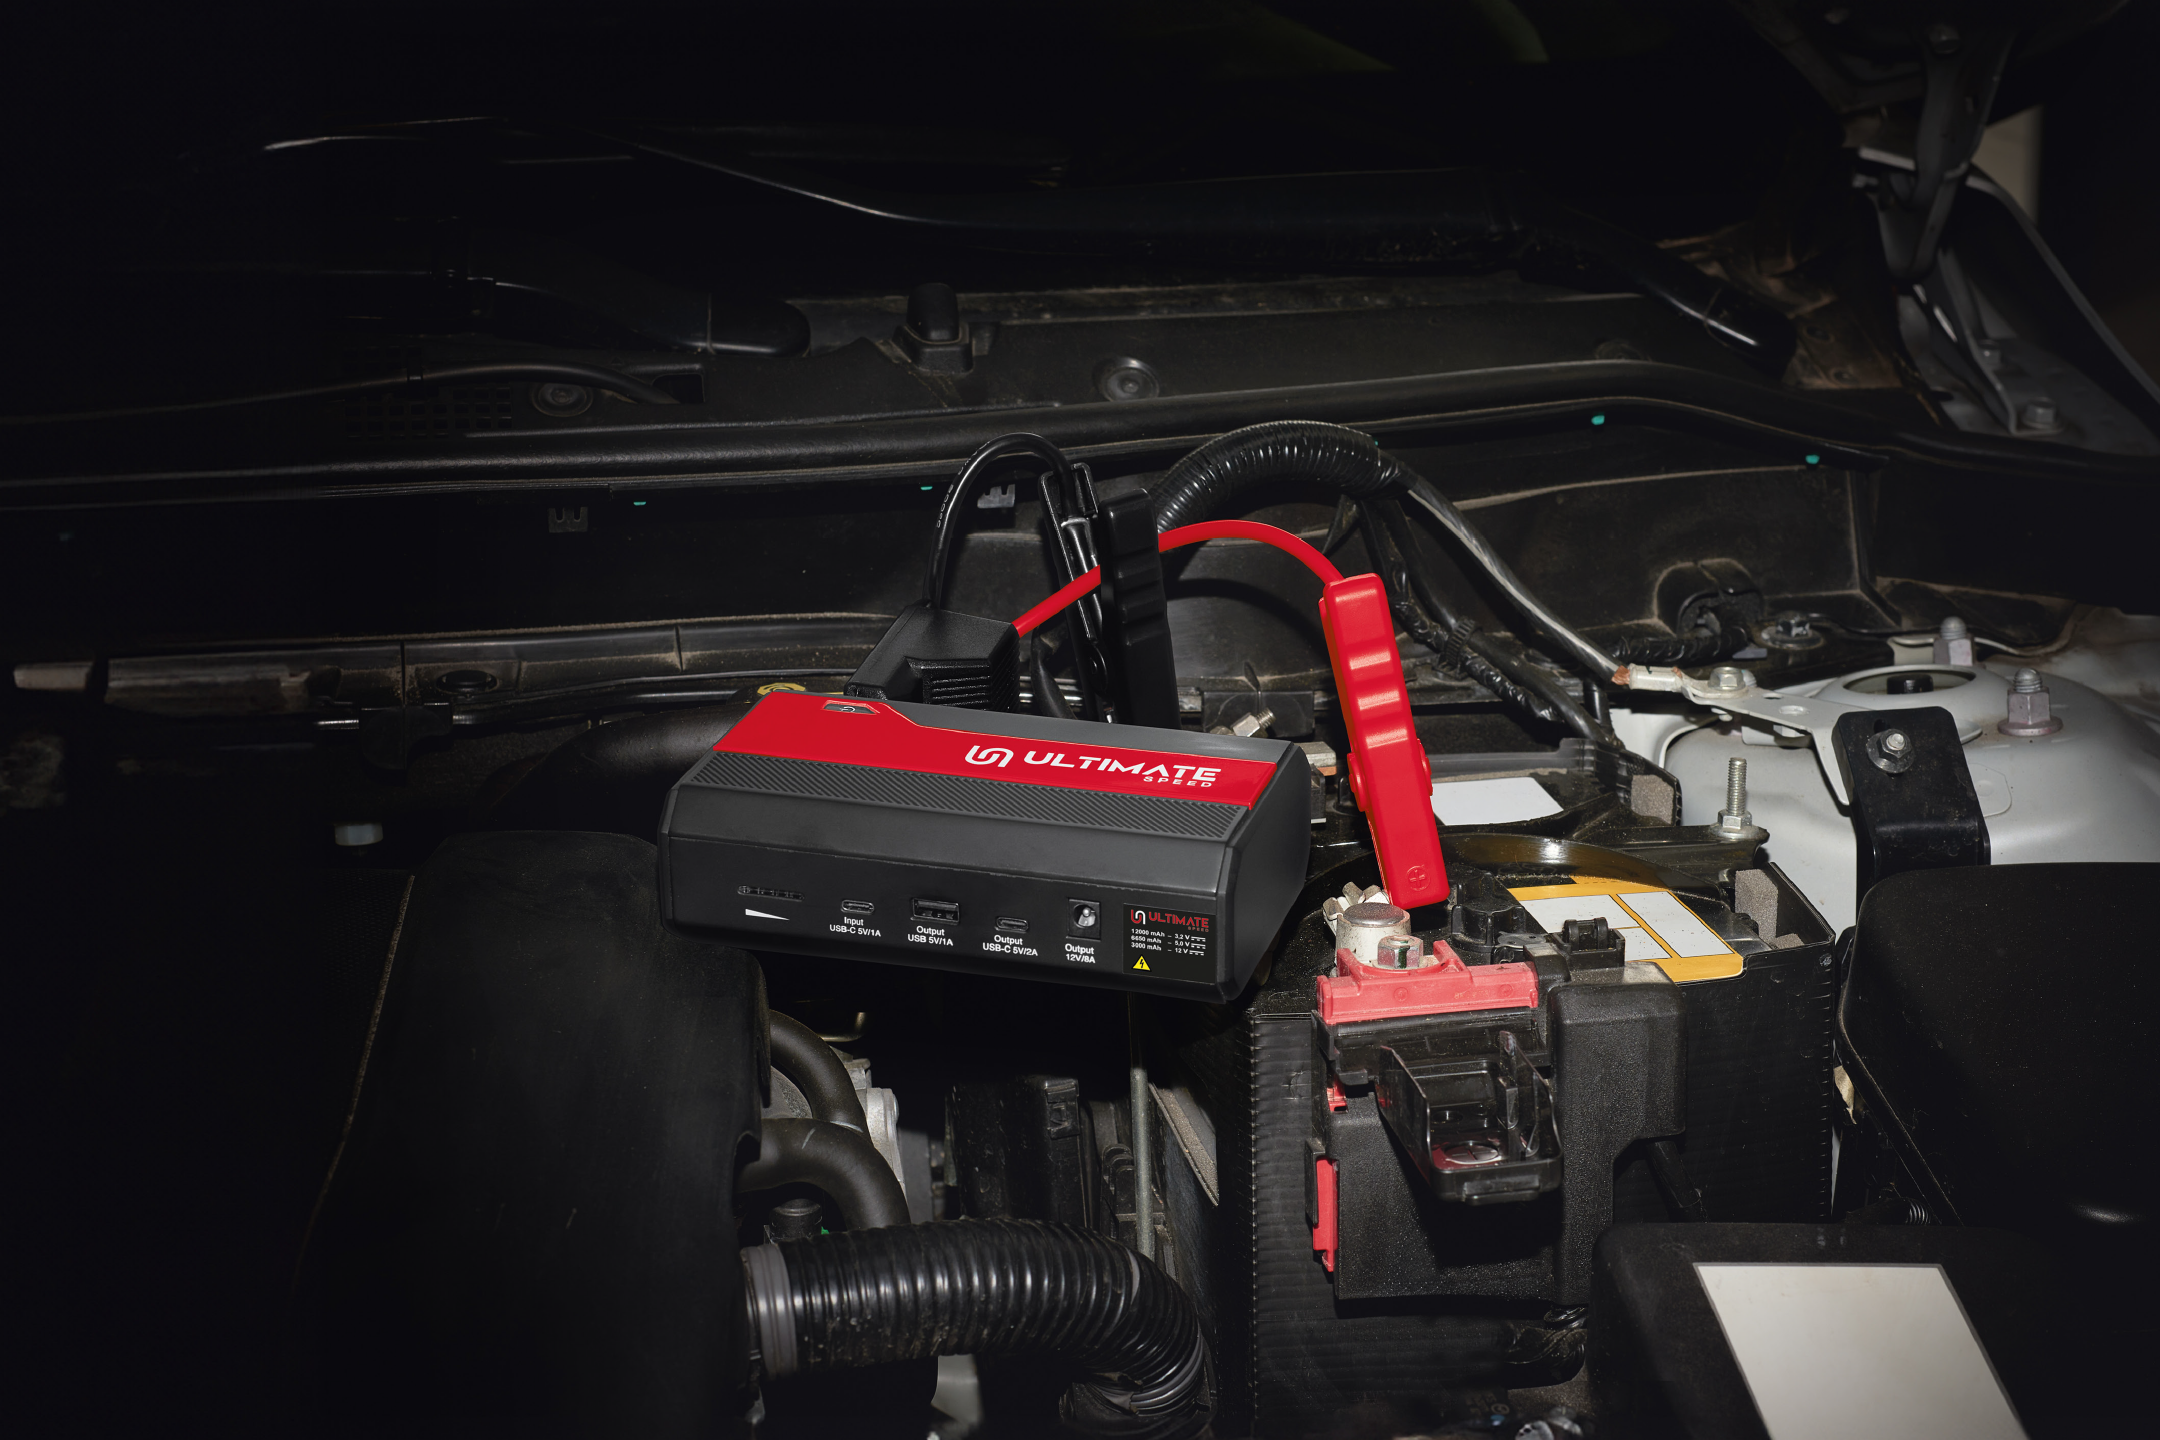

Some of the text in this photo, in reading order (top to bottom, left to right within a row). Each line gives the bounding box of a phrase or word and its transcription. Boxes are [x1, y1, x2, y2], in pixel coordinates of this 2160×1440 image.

[1023, 750, 1222, 782] ULTIMATE
[1143, 776, 1212, 788] SPEED
[843, 916, 864, 926] Input
[1149, 911, 1209, 928] ULTIMATE
[829, 924, 881, 937] USB-C 5V/1A
[916, 925, 945, 936] Output
[1131, 928, 1150, 936] 12000
[907, 933, 954, 946] USB 5V/1A
[994, 934, 1023, 945] Output
[982, 942, 1038, 956] USB-C 5V/2A
[1064, 943, 1094, 954] Output
[1066, 953, 1096, 964] 12V/8A
